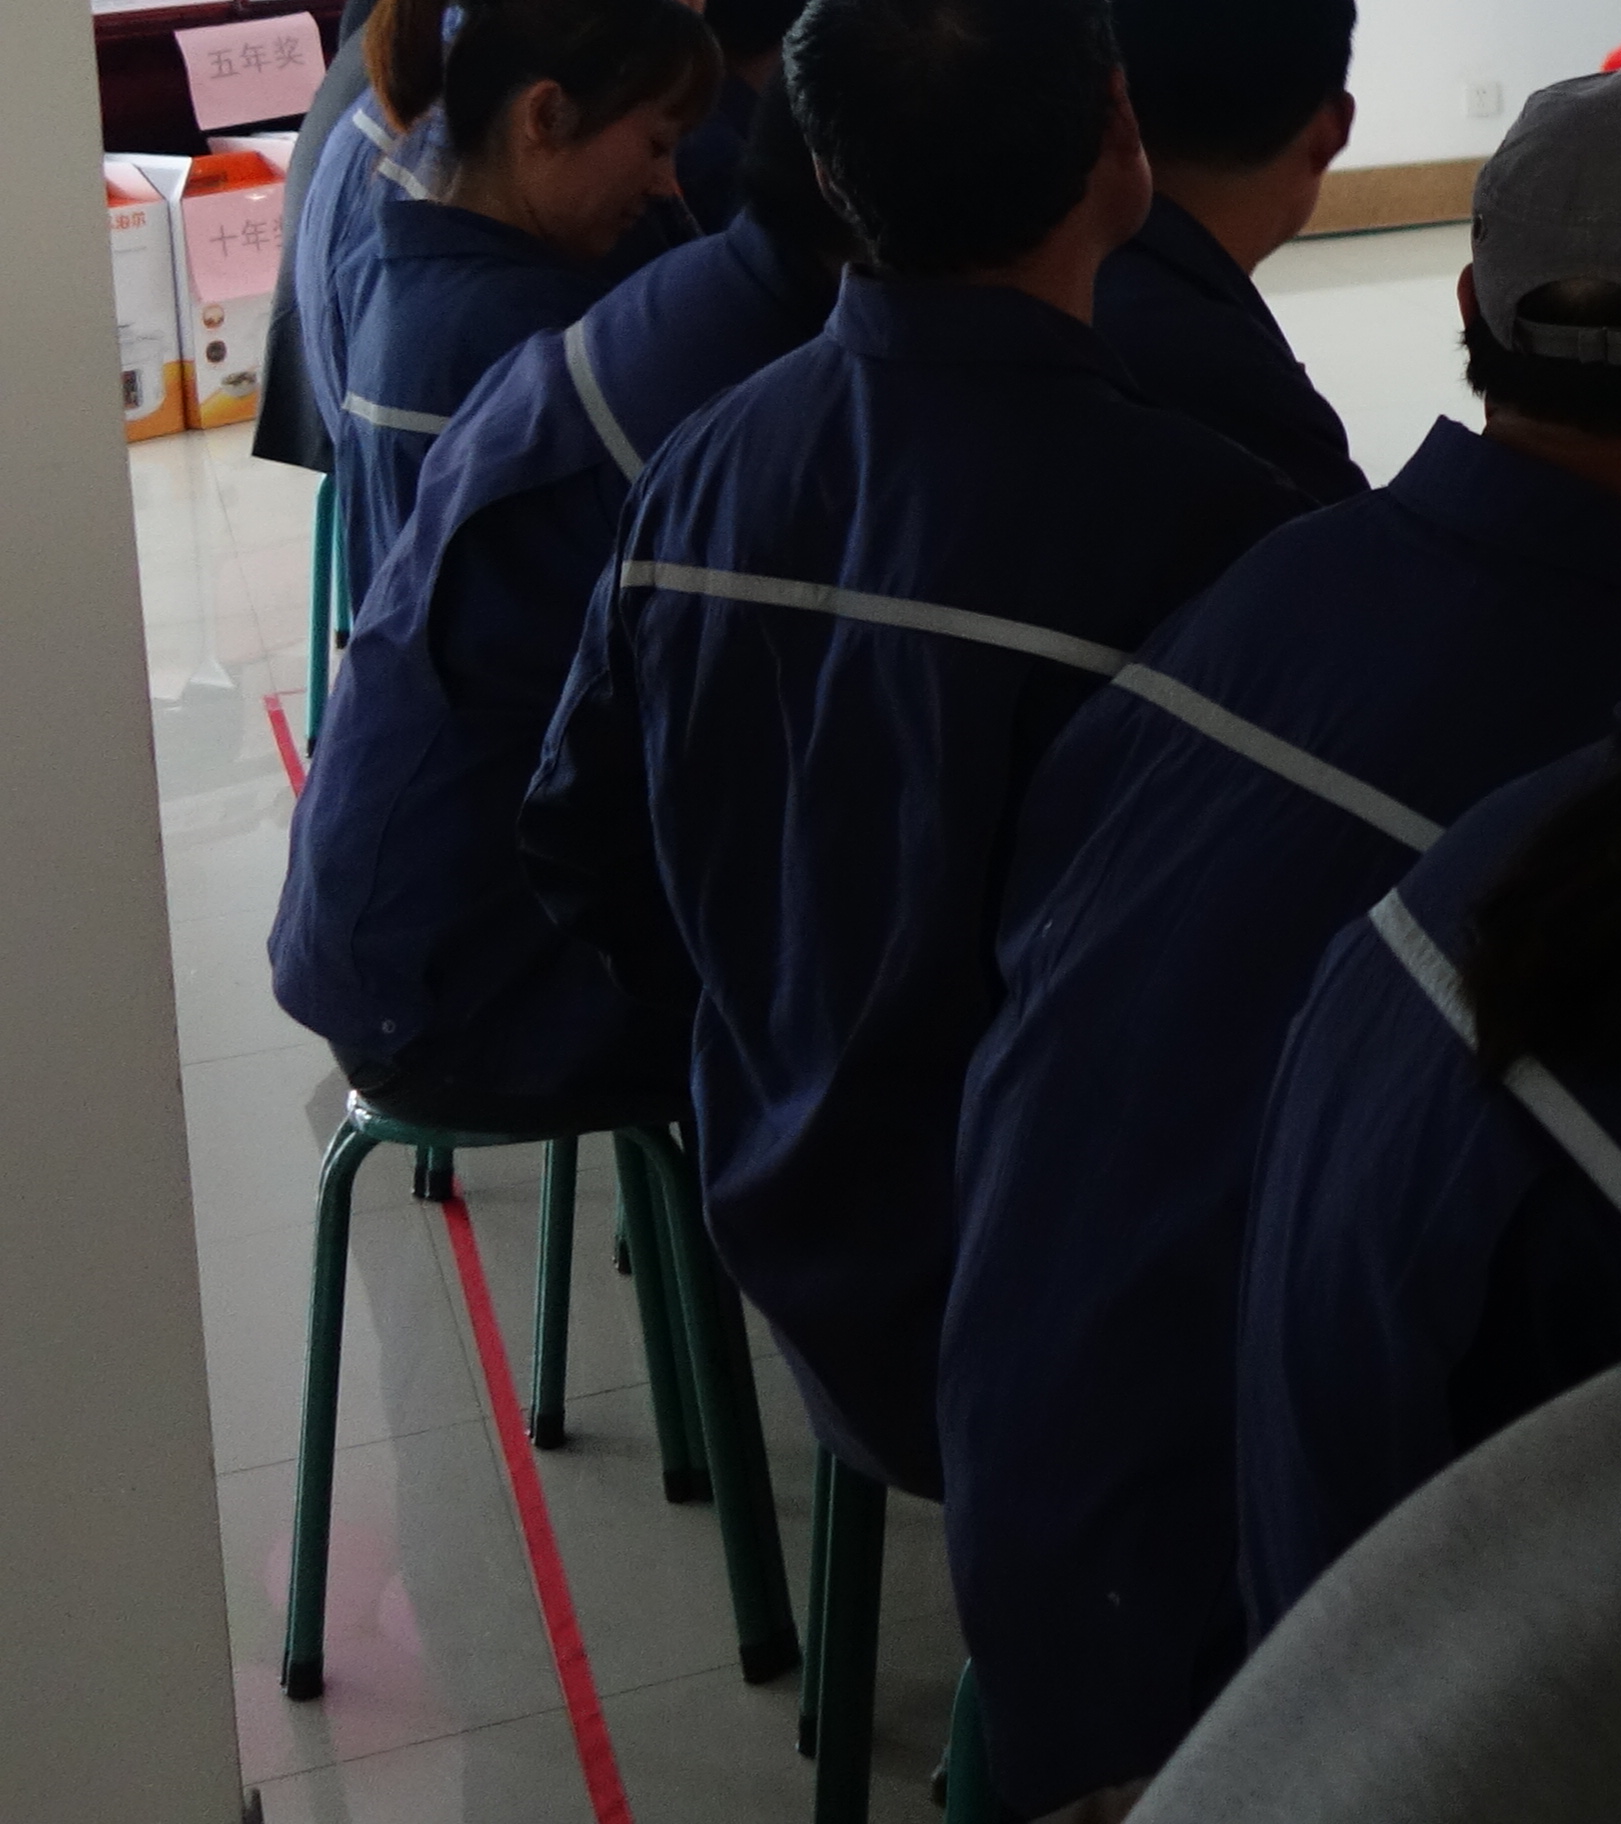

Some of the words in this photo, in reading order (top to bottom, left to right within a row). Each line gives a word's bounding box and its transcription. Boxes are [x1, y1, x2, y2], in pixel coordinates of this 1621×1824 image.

[207, 36, 306, 79] 五年奖
[107, 211, 146, 231] 泊尔
